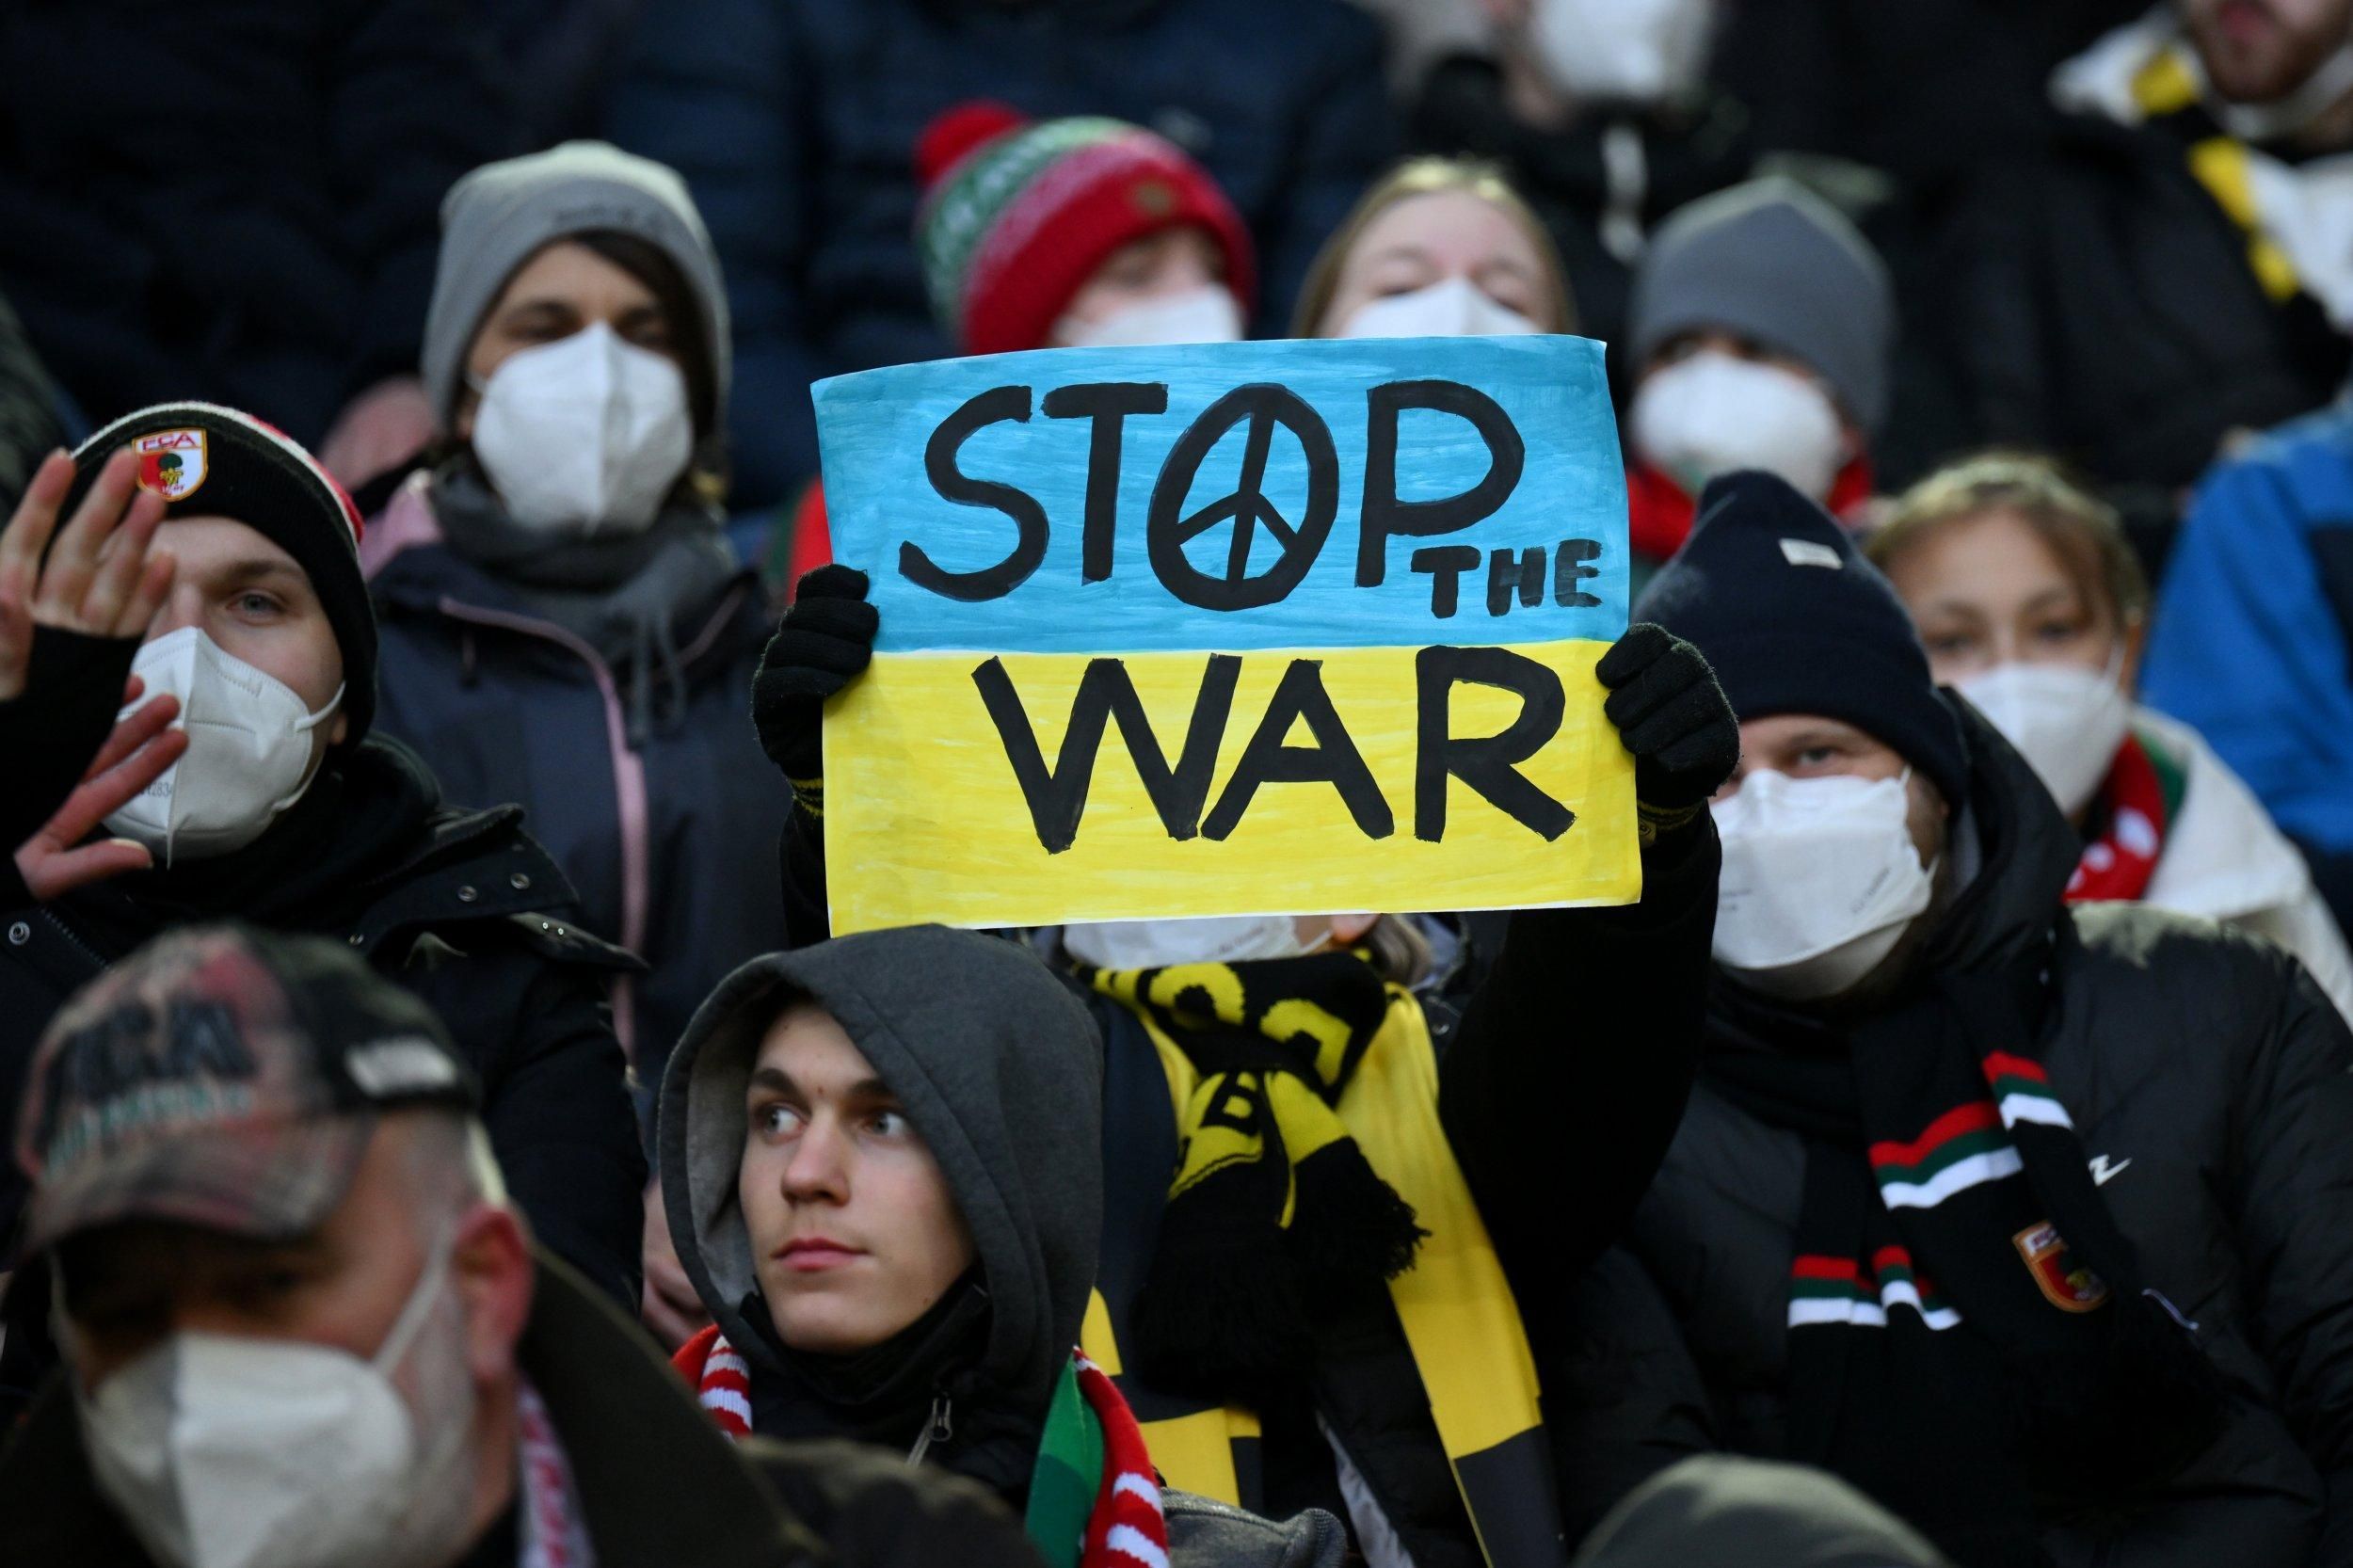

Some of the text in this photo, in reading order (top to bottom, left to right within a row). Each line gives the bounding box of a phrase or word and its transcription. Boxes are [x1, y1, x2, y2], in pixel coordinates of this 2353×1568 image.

[142, 433, 197, 451] FCA
[898, 379, 1526, 611] STOP
[1410, 538, 1603, 618] THE
[971, 645, 1577, 855] WAR
